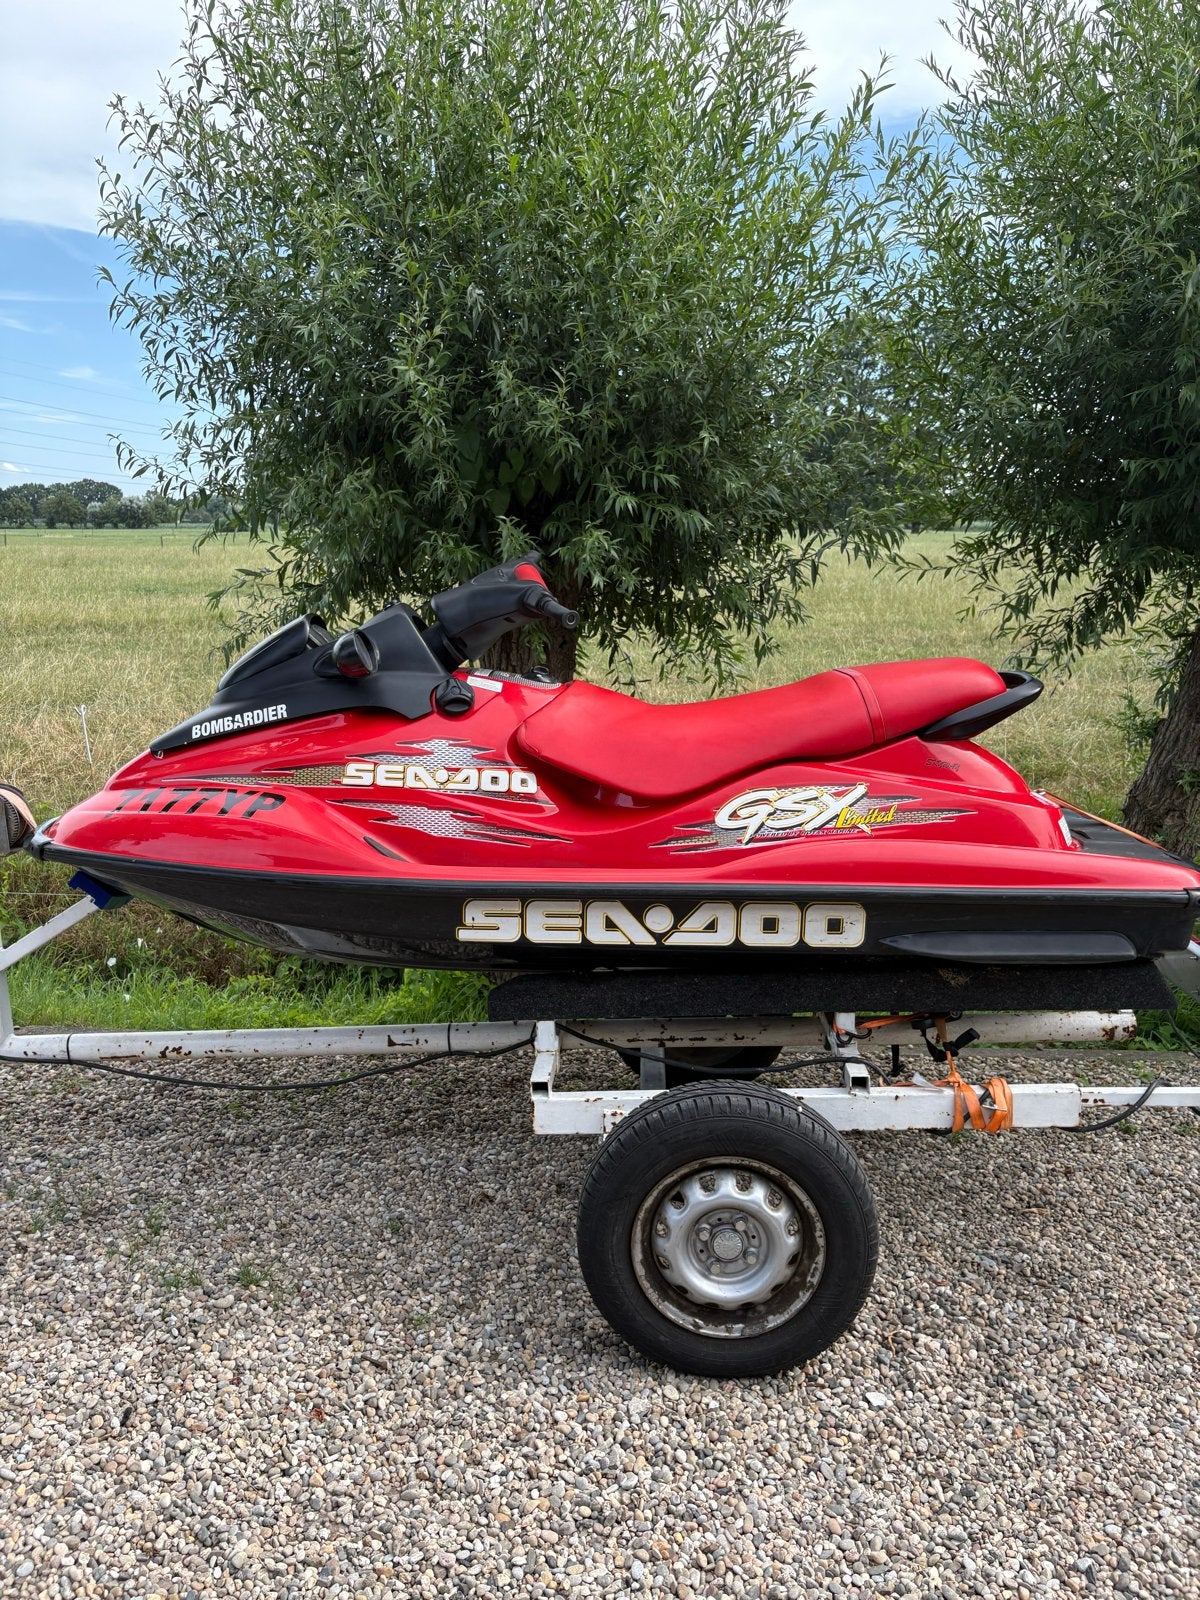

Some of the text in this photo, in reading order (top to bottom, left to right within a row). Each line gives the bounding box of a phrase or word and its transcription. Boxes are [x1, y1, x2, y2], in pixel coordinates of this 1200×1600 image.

[191, 703, 288, 739] BOMBARDIER
[714, 782, 898, 846] GSX Limited
